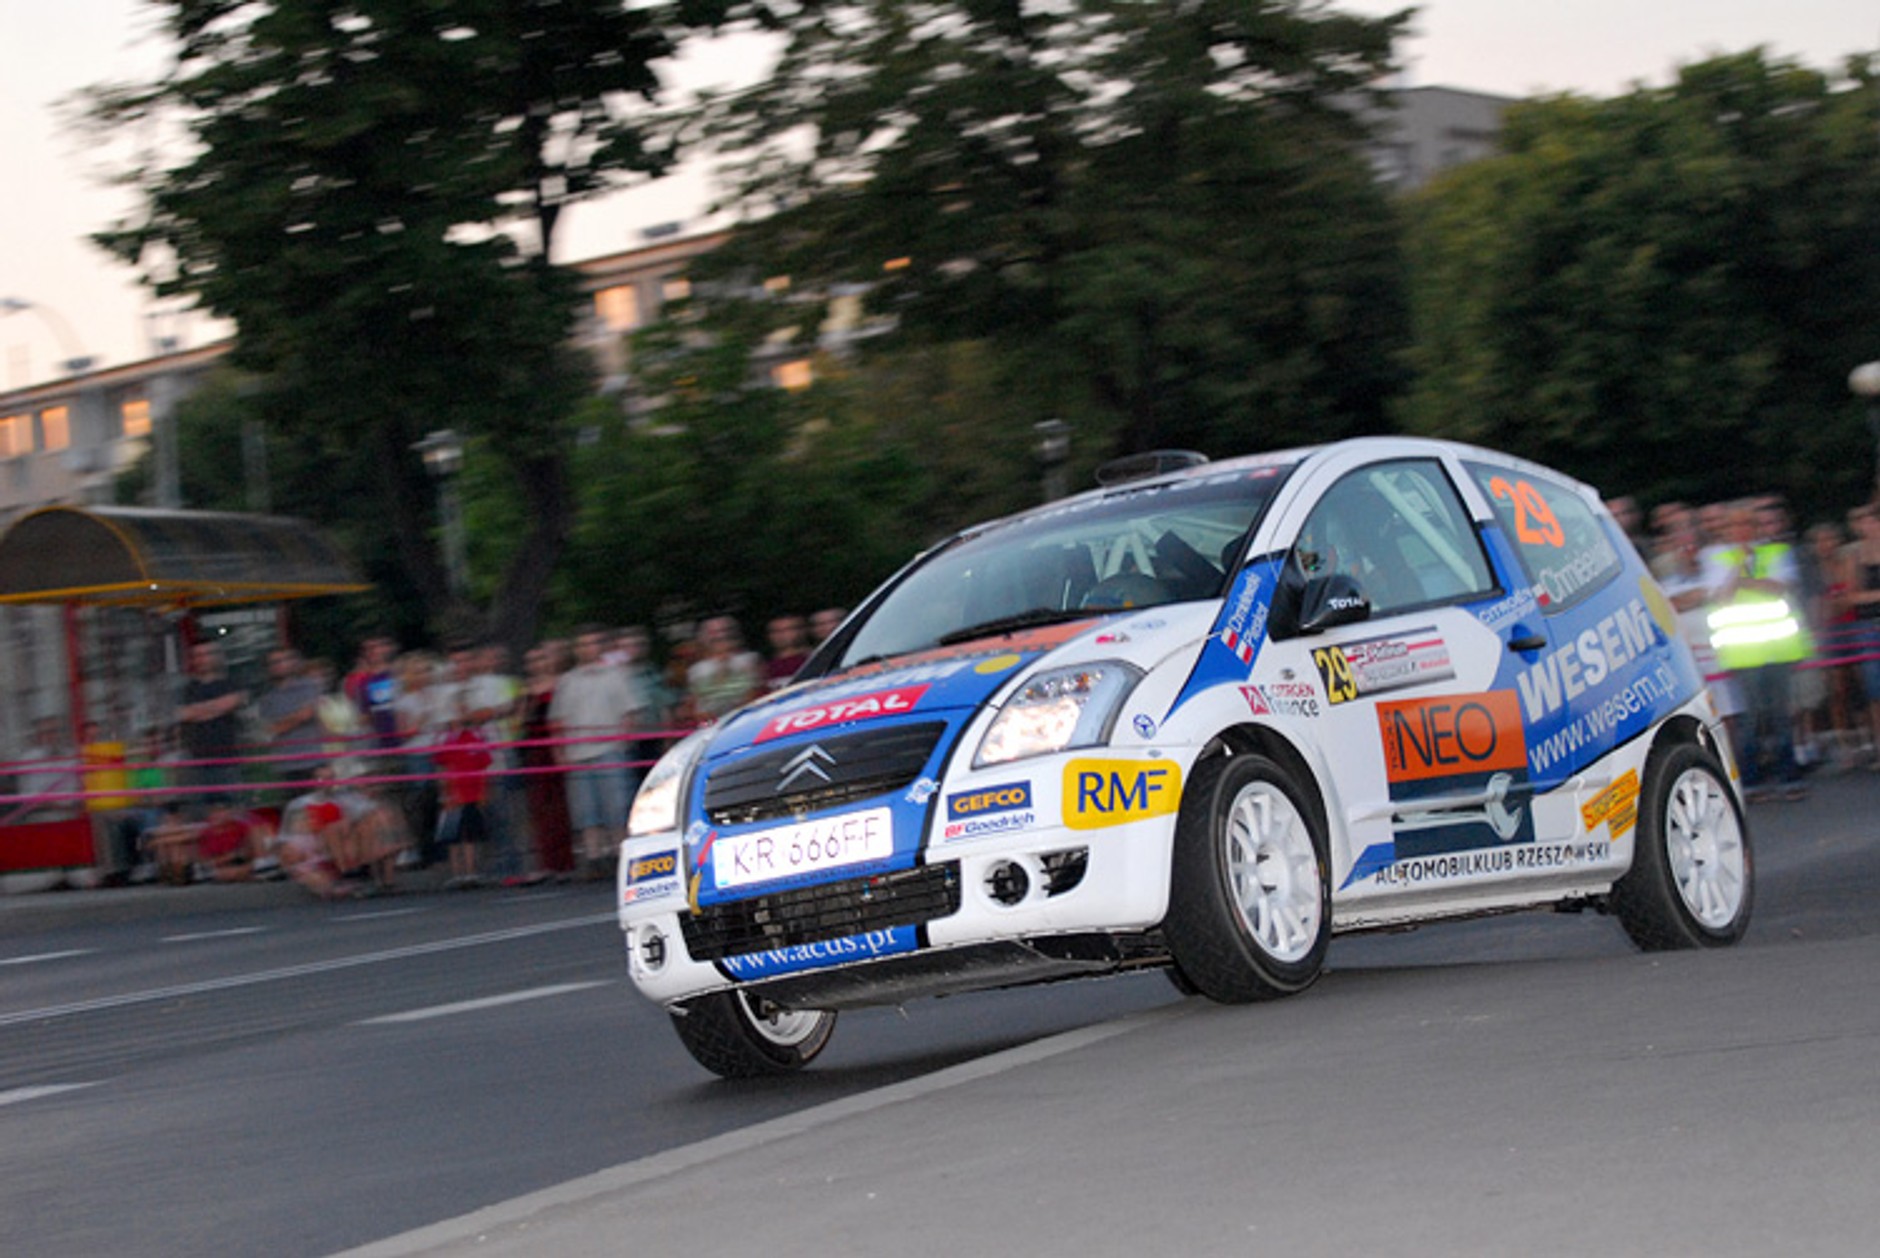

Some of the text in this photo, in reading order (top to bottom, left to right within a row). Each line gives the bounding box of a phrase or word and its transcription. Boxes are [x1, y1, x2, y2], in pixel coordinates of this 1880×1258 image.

[1490, 476, 1566, 548] 29
[1314, 646, 1357, 703] 29
[1516, 599, 1656, 724] WESEM
[774, 693, 909, 733] TOTAL
[1393, 702, 1497, 770] NEO
[1528, 655, 1680, 774] www.wesem.pl
[953, 788, 1026, 813] GEFCO
[1077, 768, 1167, 814] RMF
